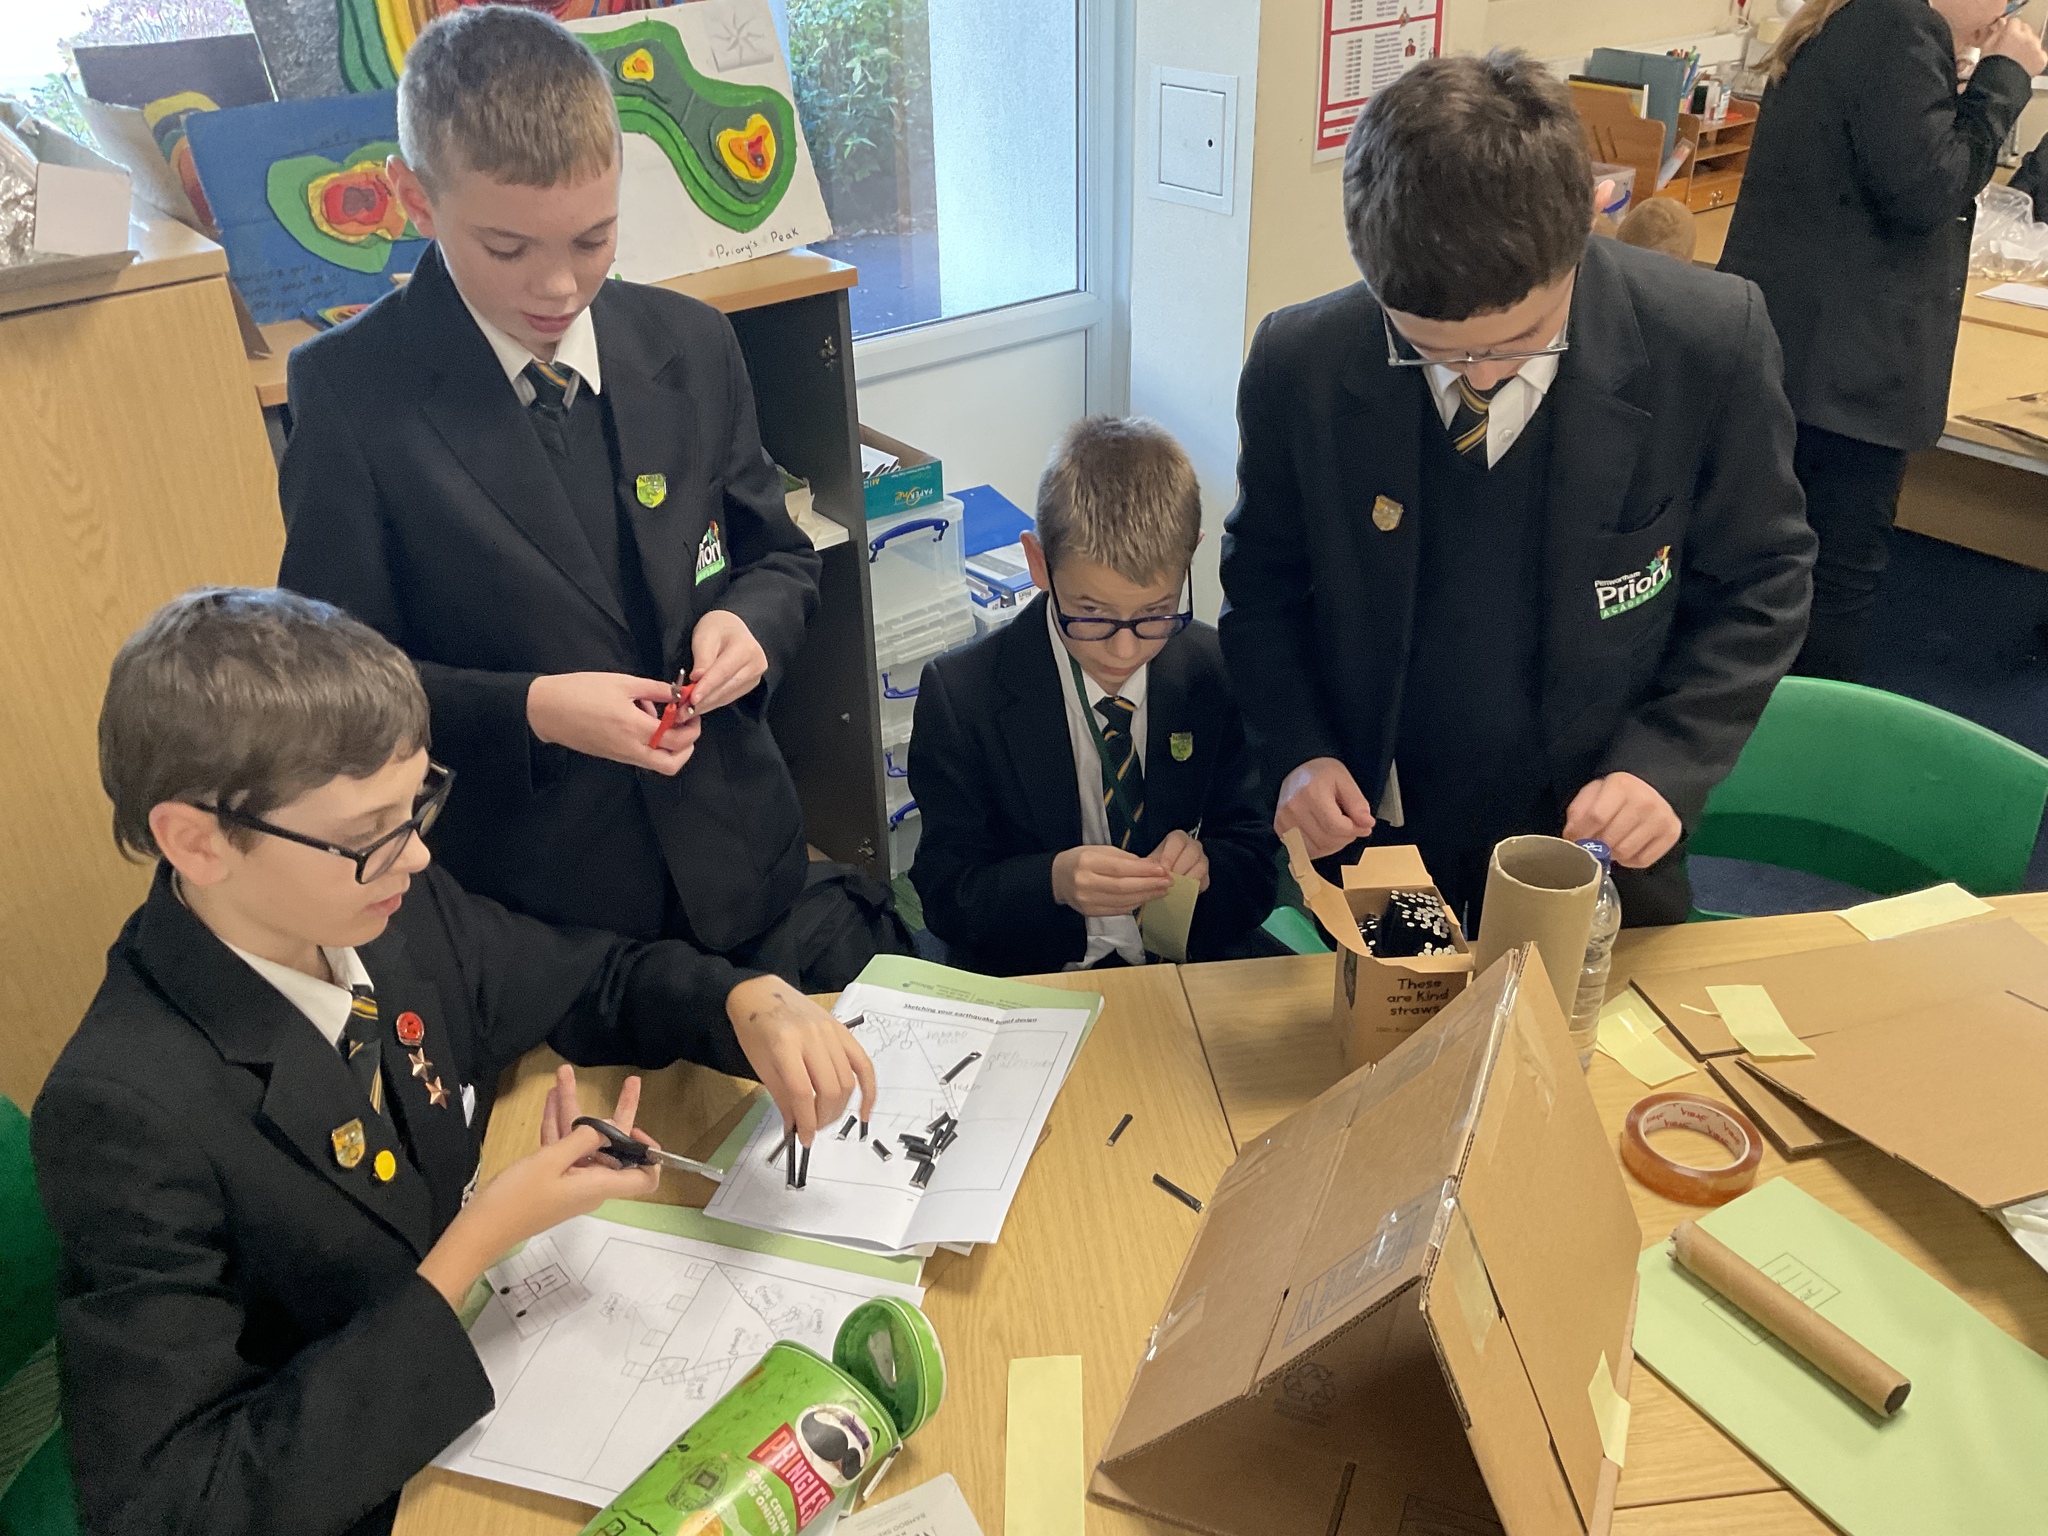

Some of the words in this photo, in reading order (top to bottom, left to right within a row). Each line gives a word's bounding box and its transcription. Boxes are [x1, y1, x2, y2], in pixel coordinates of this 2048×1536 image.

[716, 241, 757, 258] Priory's
[770, 227, 799, 243] Peak
[1596, 557, 1669, 610] Priory
[1603, 588, 1655, 617] ACADEMY
[1386, 995, 1412, 1003] are
[1416, 988, 1449, 1002] Kind
[1397, 978, 1441, 990] These
[903, 1003, 936, 1014] Sketching
[954, 1012, 995, 1024] earthquake
[1390, 1006, 1440, 1016] straws
[1680, 1107, 1708, 1122] VIBAC
[757, 1430, 831, 1527] PRINGLES
[746, 1468, 773, 1499] SOUR
[770, 1498, 791, 1536] CREAM
[747, 1486, 758, 1497] &
[755, 1496, 780, 1535] ONION
[893, 1512, 926, 1531] BAMBOO
